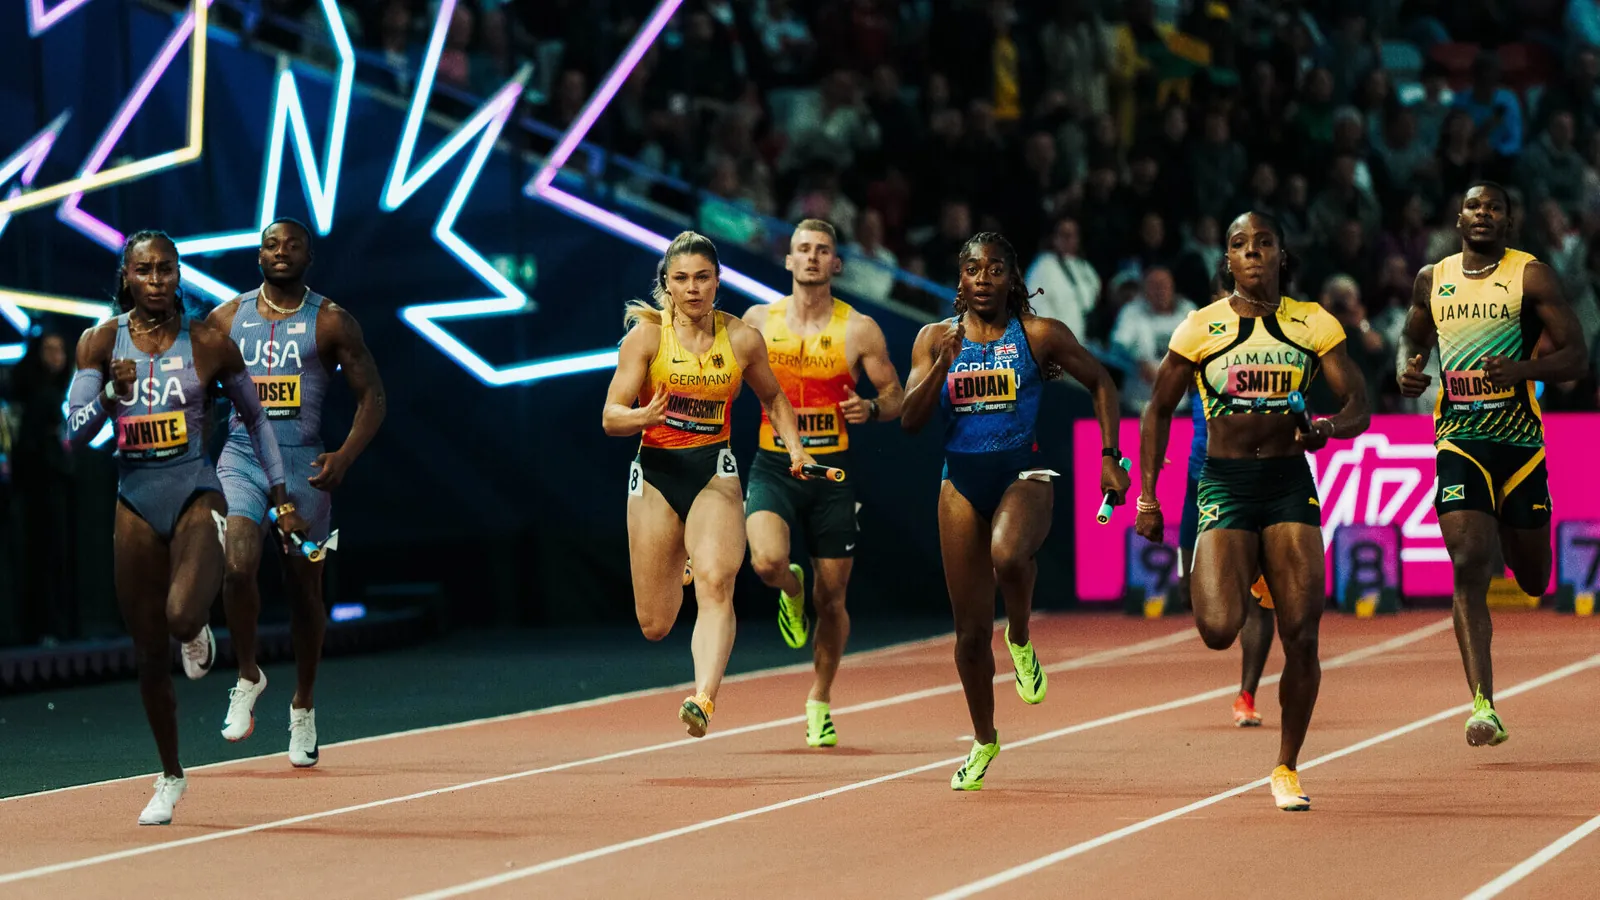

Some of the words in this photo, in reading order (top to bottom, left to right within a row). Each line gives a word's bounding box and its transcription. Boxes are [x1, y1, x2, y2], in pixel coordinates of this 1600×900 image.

[1439, 303, 1510, 322] JAMAICA
[240, 338, 302, 368] USA
[768, 351, 837, 369] GERMANY
[1221, 351, 1305, 370] JAMAICA
[669, 373, 732, 386] GERMANY
[954, 374, 1009, 399] EDUAN
[1236, 370, 1293, 393] SMITH
[71, 401, 97, 431] USA
[797, 413, 835, 432] NTER
[124, 418, 180, 446] WHITE
[723, 454, 736, 474] 8
[631, 468, 639, 491] 8
[1142, 543, 1177, 592] 9
[1351, 541, 1384, 588] 8
[1572, 537, 1600, 589] 7
